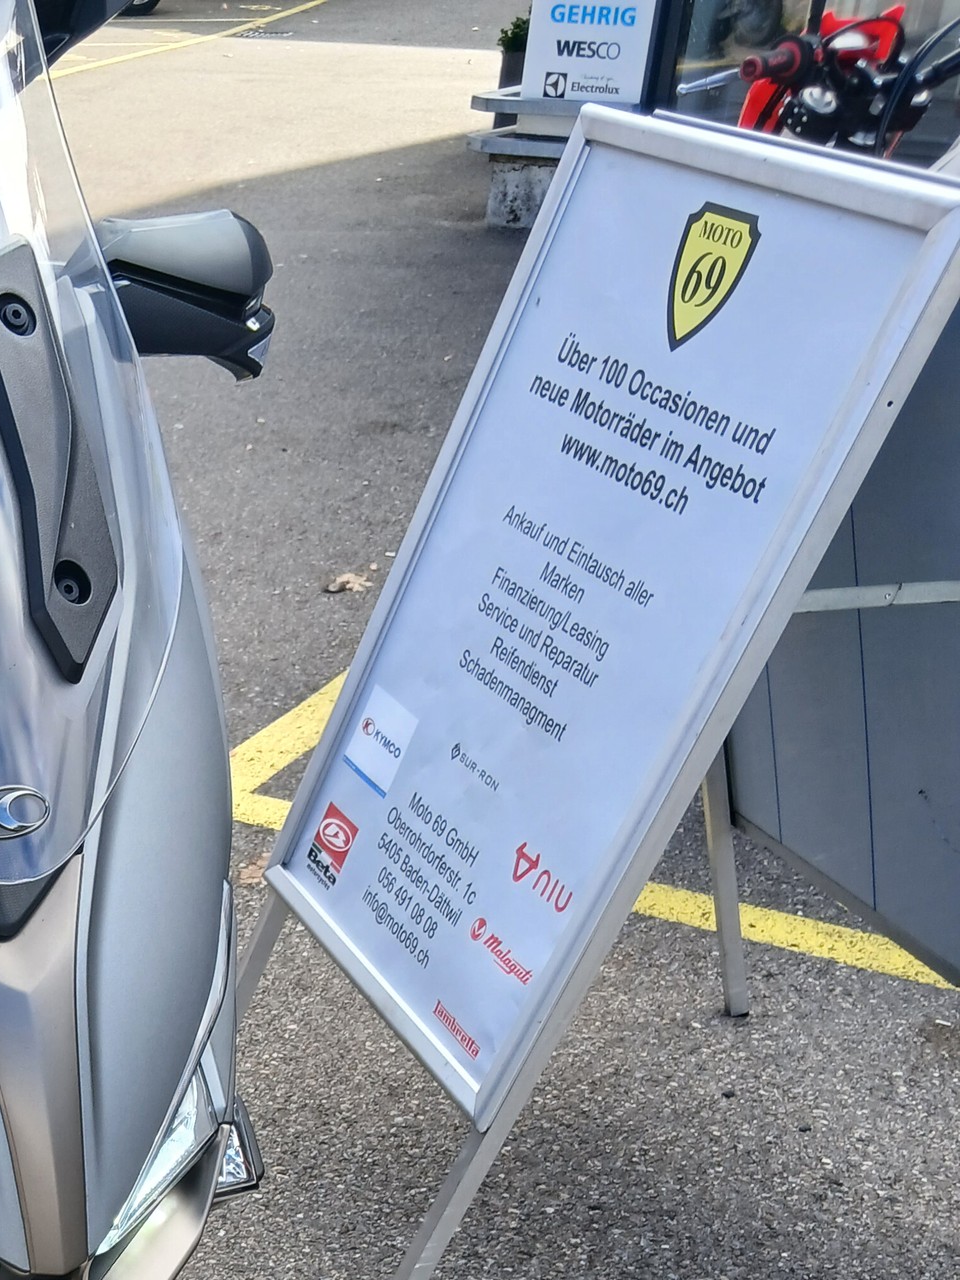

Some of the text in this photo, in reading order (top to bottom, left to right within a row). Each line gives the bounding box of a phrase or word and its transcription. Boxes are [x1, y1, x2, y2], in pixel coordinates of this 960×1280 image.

[550, 4, 637, 27] GEHRIG
[556, 40, 620, 60] WESCO
[571, 82, 620, 95] Electrolux
[698, 220, 743, 249] MOTO
[681, 252, 727, 307] 69
[558, 332, 776, 455] Über 100 Occasionen und
[529, 374, 768, 504] neue Motorräder im Angebot
[561, 434, 689, 515] www.moto69.ch
[502, 505, 655, 608] Ankauf und Eintausch aller
[539, 562, 585, 604] Marken
[478, 593, 599, 688] Service und Reparatur
[491, 567, 610, 662] Finanzierung/Leasing
[459, 649, 567, 742] Schadenmanagment
[491, 637, 559, 698] Reifendienst
[374, 729, 401, 759] KYMCO
[307, 847, 336, 886] Beta
[387, 806, 477, 905] Oberrohrdorferstr. 1c
[409, 792, 480, 868] Moto 69 GmbH
[377, 834, 463, 927] 5405 Baden-Dättwil
[378, 866, 438, 939] 056 491 08 08
[362, 886, 430, 968] info@moto69.ch
[484, 932, 533, 985] Malaguti
